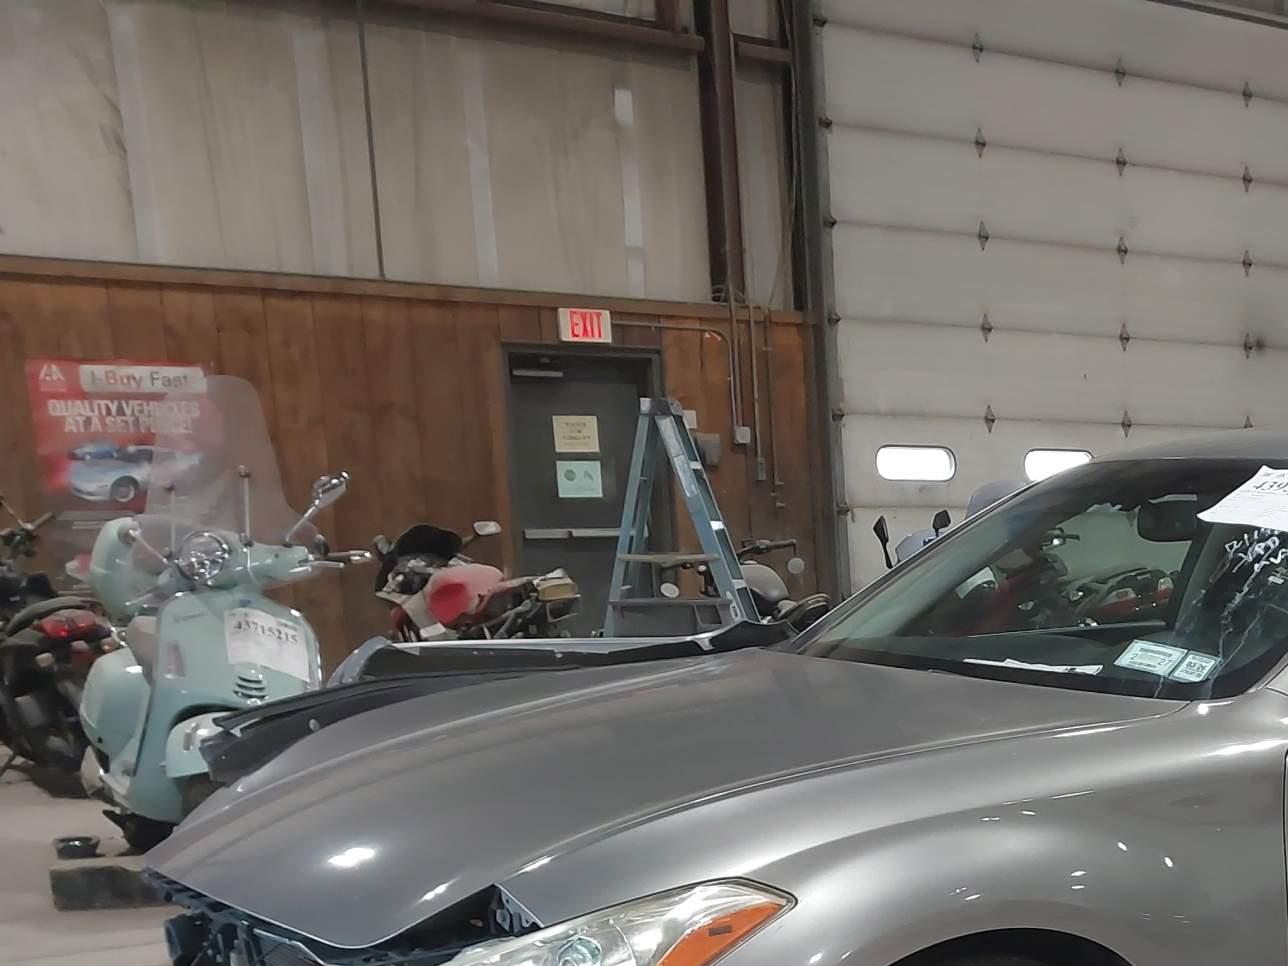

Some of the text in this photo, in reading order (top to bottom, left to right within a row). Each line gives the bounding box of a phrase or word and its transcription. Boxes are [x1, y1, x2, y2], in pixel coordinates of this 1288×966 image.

[570, 311, 602, 338] EXIT
[150, 371, 188, 388] Fast
[48, 400, 119, 416] QUALITY
[64, 416, 87, 432] AT
[90, 416, 103, 432] A
[106, 416, 135, 432] SET
